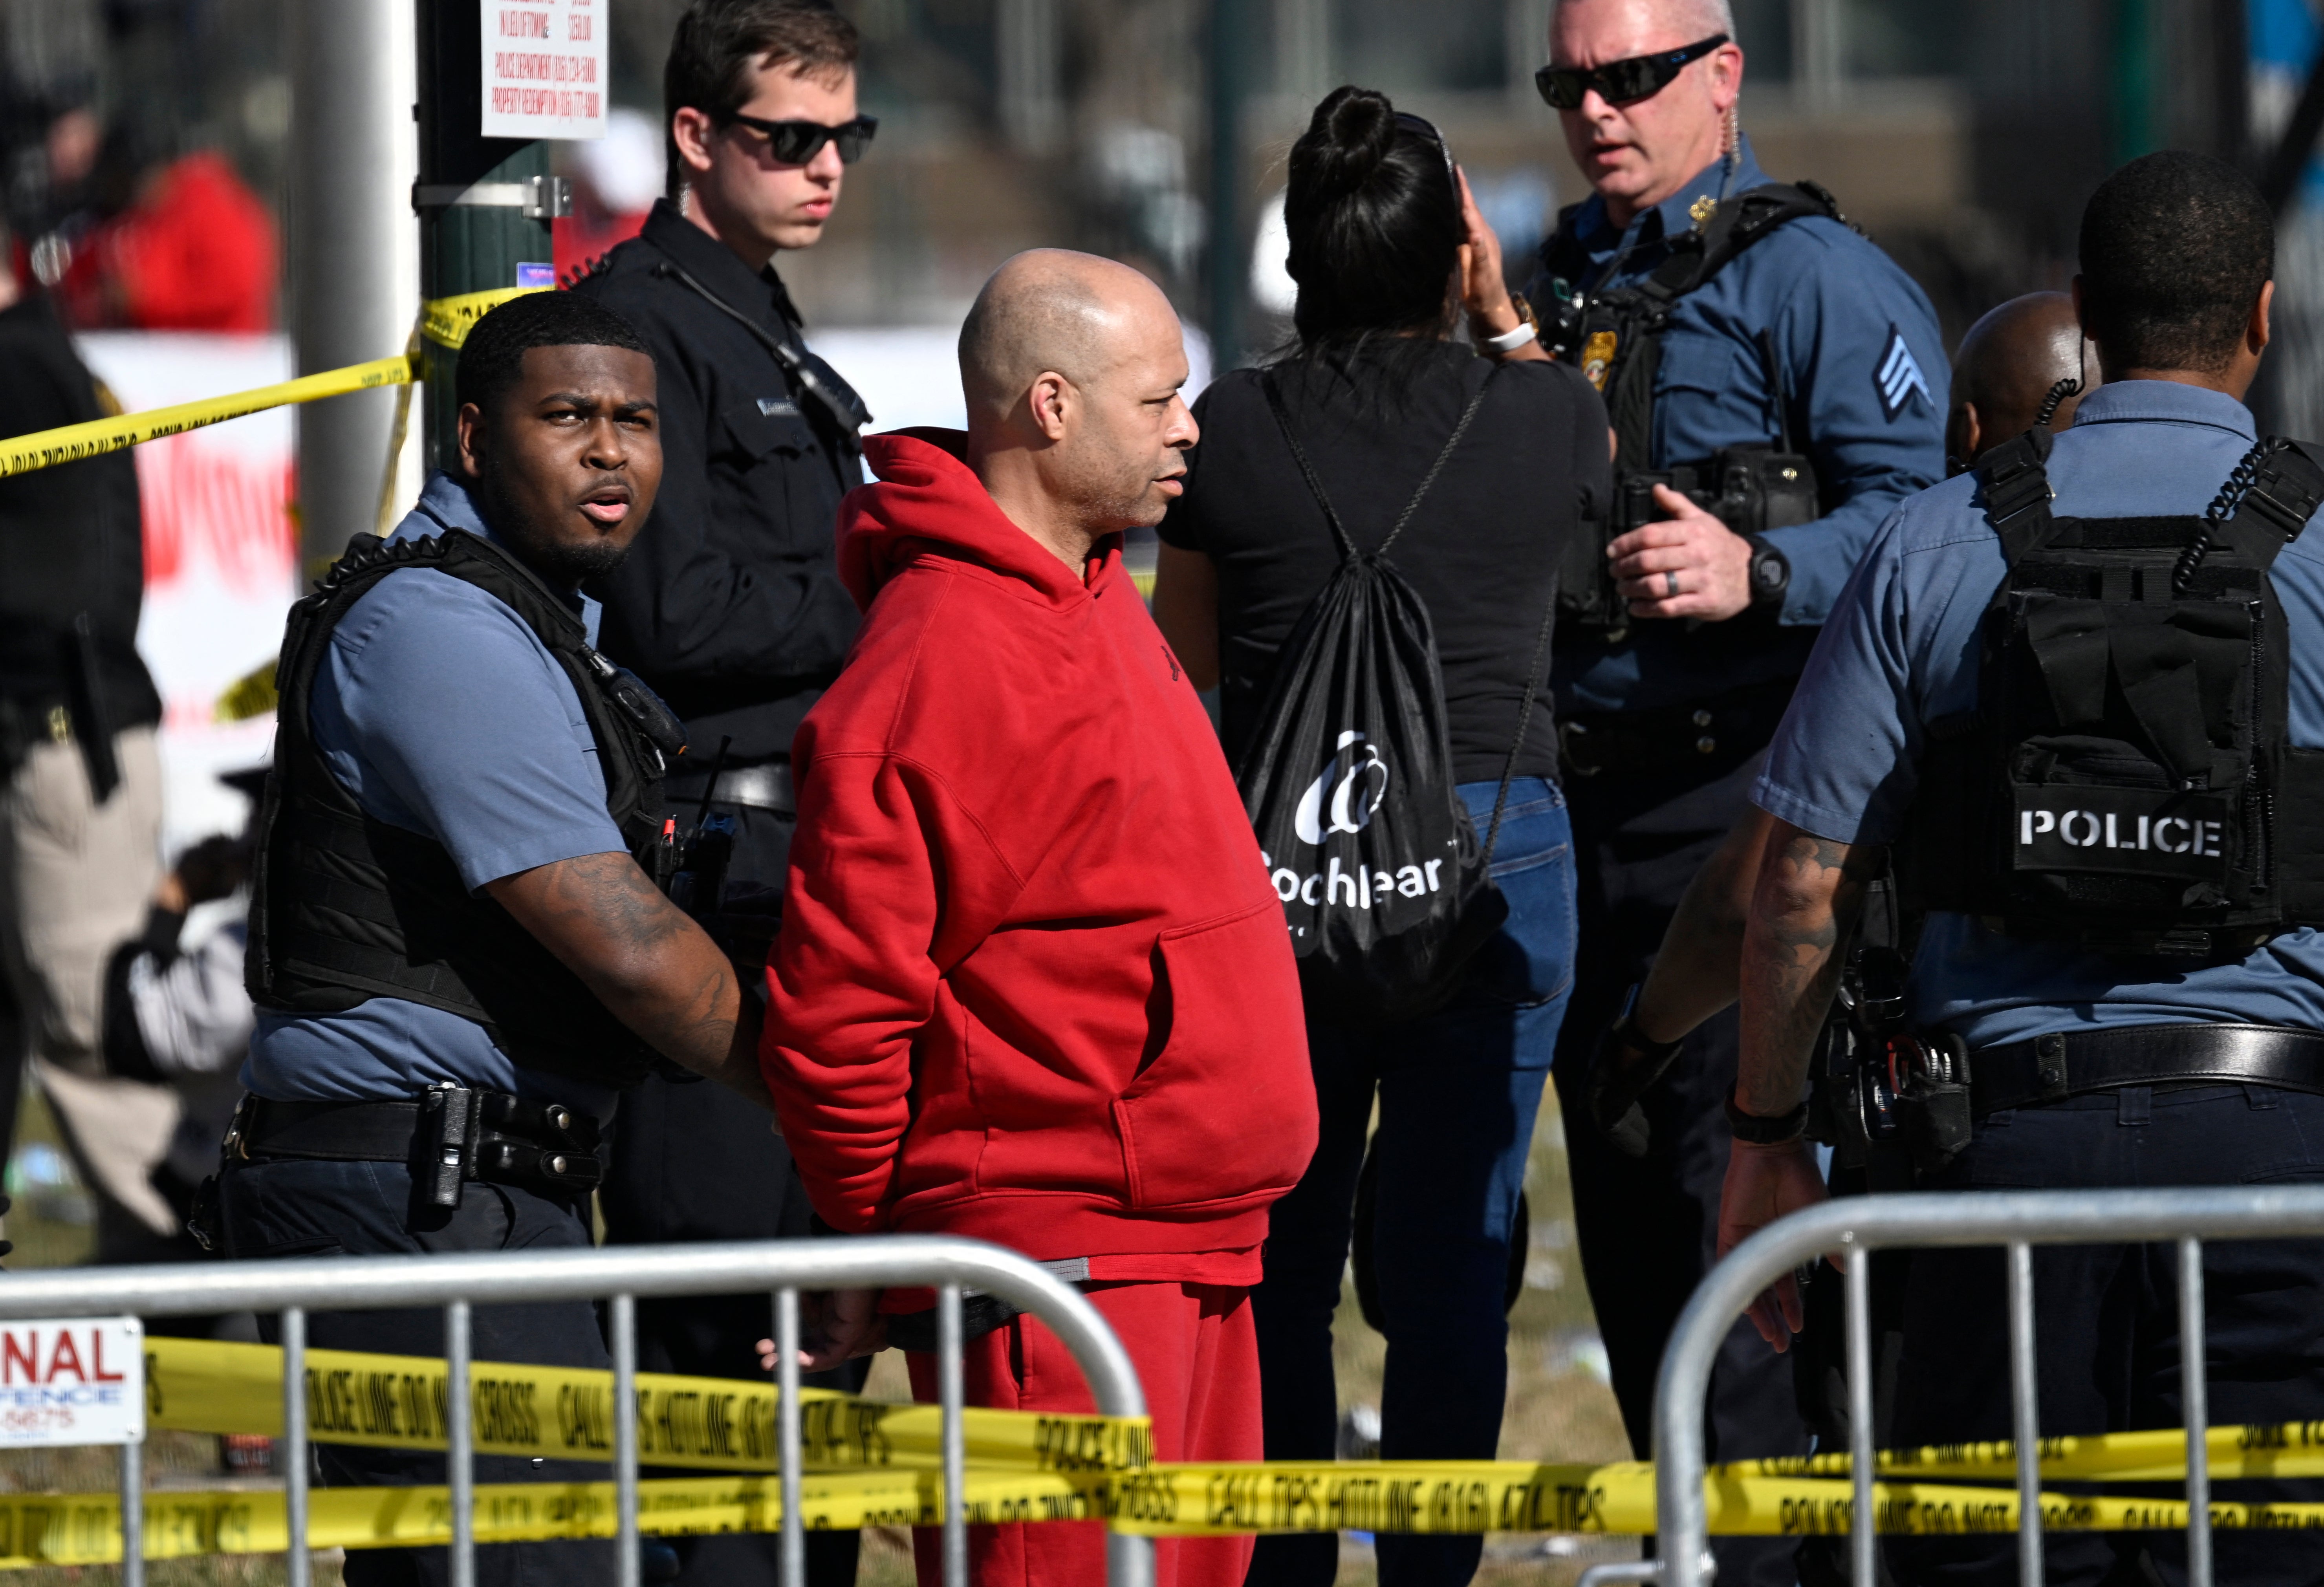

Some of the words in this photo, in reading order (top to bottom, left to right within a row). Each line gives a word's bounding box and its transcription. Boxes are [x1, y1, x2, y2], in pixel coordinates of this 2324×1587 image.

[495, 52, 515, 79] POLICE
[516, 53, 551, 81] DEPARTMENT
[491, 87, 521, 114] PROPERTY
[522, 88, 557, 116] REDEMPTION
[2020, 810, 2221, 857] POLICE
[1262, 851, 1443, 910] ochlear
[1, 1328, 126, 1384] NAL
